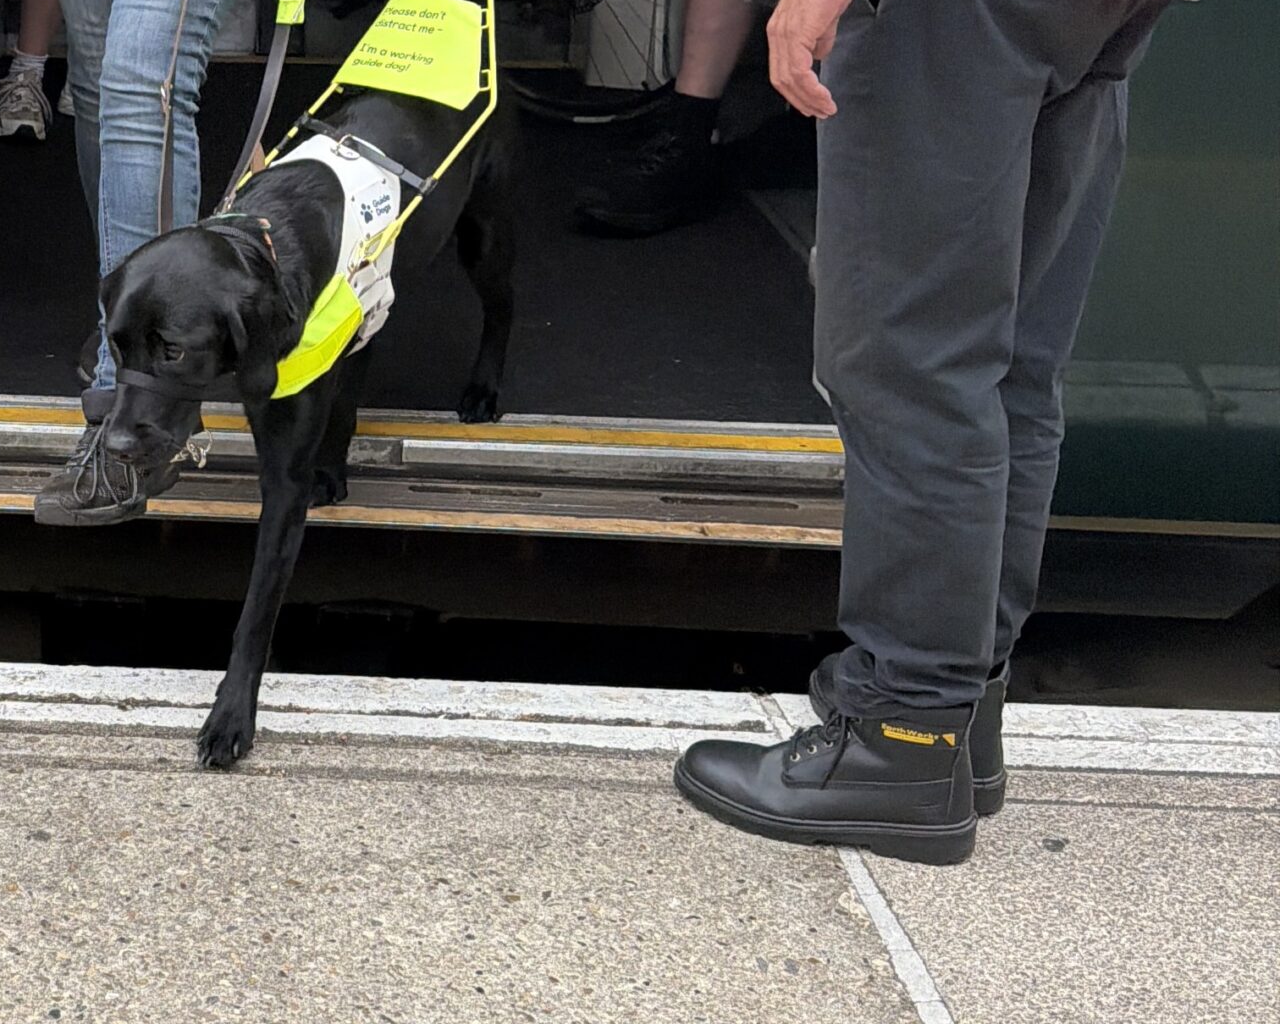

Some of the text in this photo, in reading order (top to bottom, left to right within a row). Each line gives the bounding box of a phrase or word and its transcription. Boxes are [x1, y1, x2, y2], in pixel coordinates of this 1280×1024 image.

[418, 26, 435, 34] me
[359, 43, 434, 66] I'm a working
[352, 58, 411, 73] guide dog!
[372, 193, 390, 208] Guide
[376, 204, 391, 216] Dogs
